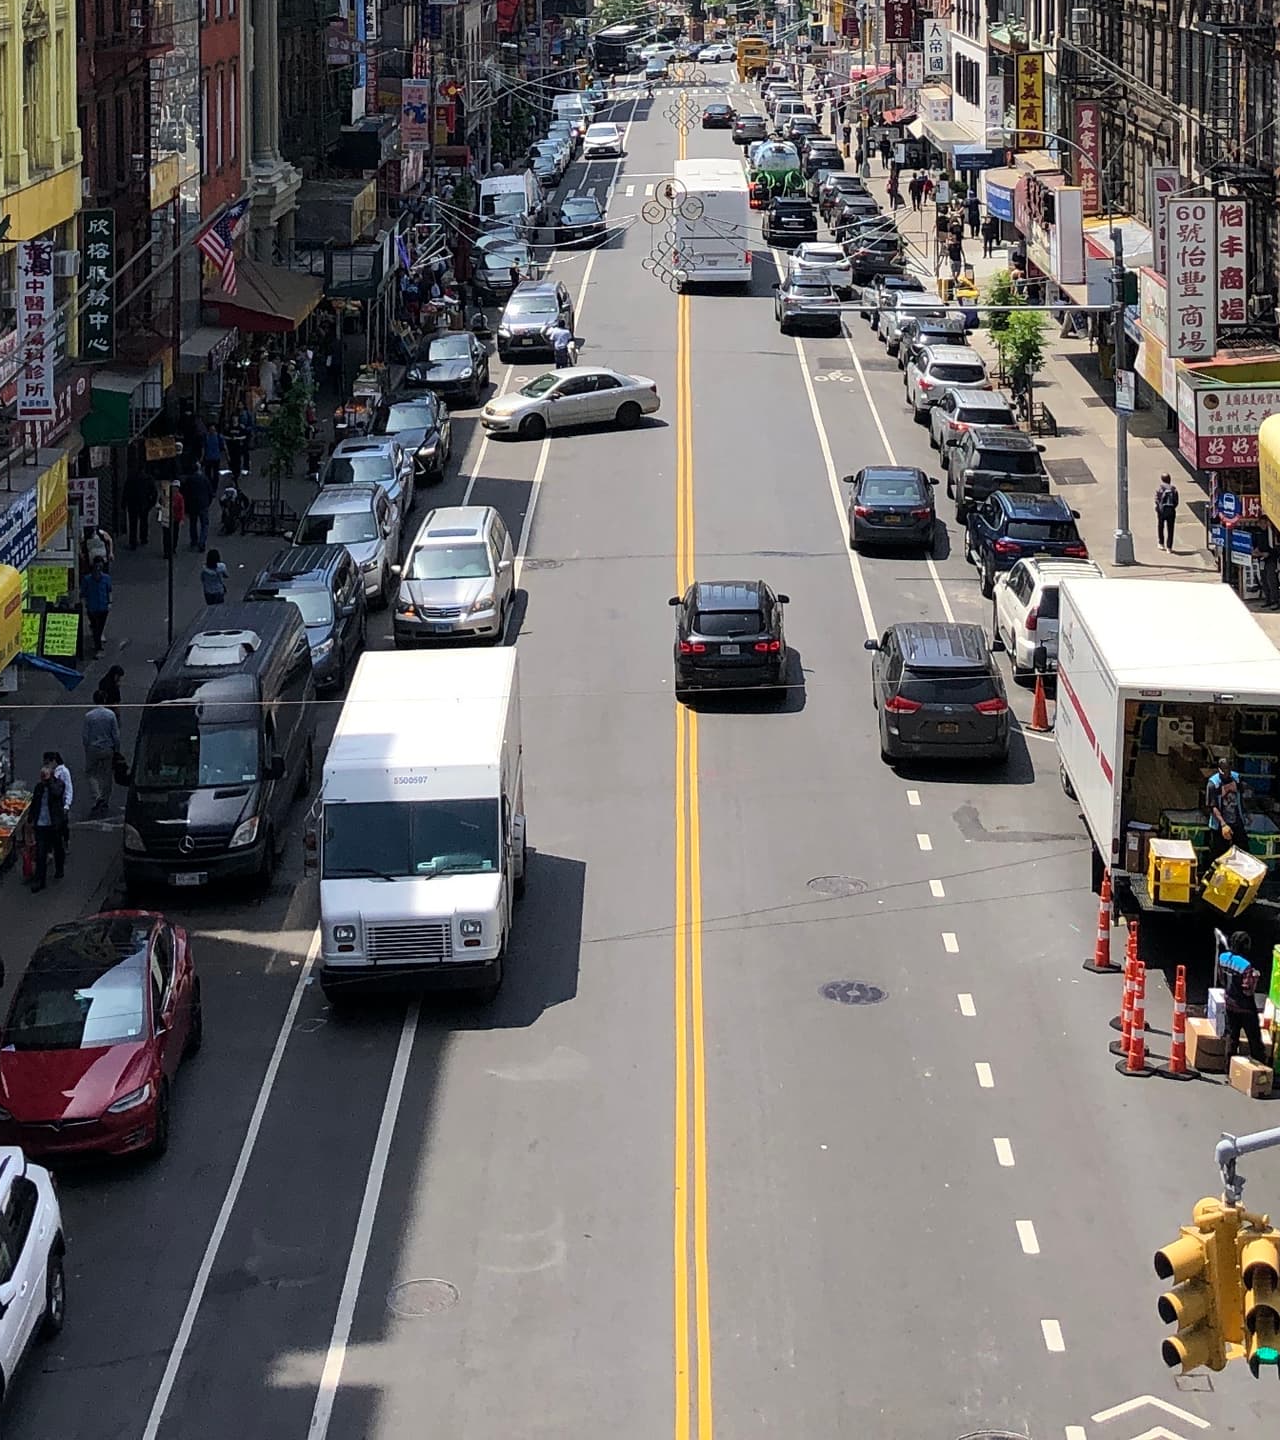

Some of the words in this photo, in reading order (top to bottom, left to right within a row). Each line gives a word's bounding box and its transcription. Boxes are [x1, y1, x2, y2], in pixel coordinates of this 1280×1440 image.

[929, 22, 943, 72] 大帝國
[87, 218, 111, 352] 欣榕服務中心
